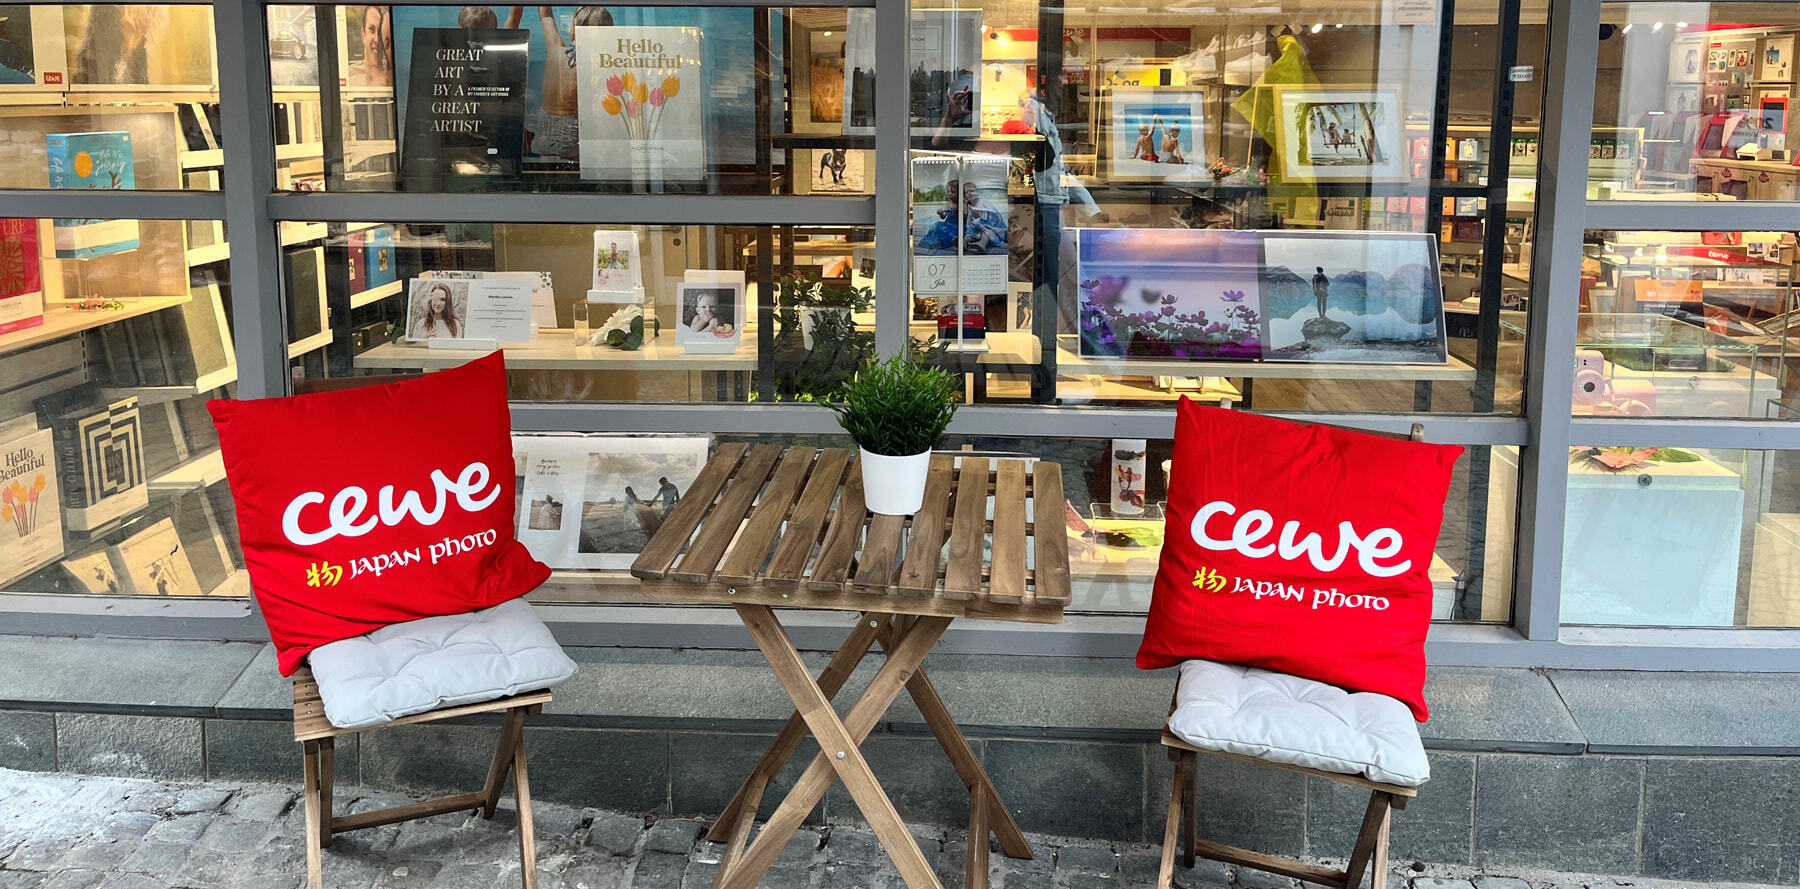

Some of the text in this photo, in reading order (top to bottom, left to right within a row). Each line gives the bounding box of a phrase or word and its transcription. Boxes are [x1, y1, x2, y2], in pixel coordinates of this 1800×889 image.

[435, 48, 484, 61] GREAT
[616, 38, 664, 57] Hello
[599, 53, 682, 69] Beautiful
[434, 66, 464, 79] ART
[433, 83, 465, 96] BY A
[431, 102, 481, 114] GREAT
[429, 119, 483, 132] ARTIST
[928, 263, 946, 277] 07
[5, 447, 34, 468] Hello
[0, 454, 46, 481] Beautiful
[282, 462, 501, 546] cewe
[1190, 501, 1412, 577] cewe
[305, 561, 343, 588] 物
[1192, 566, 1227, 593] 物
